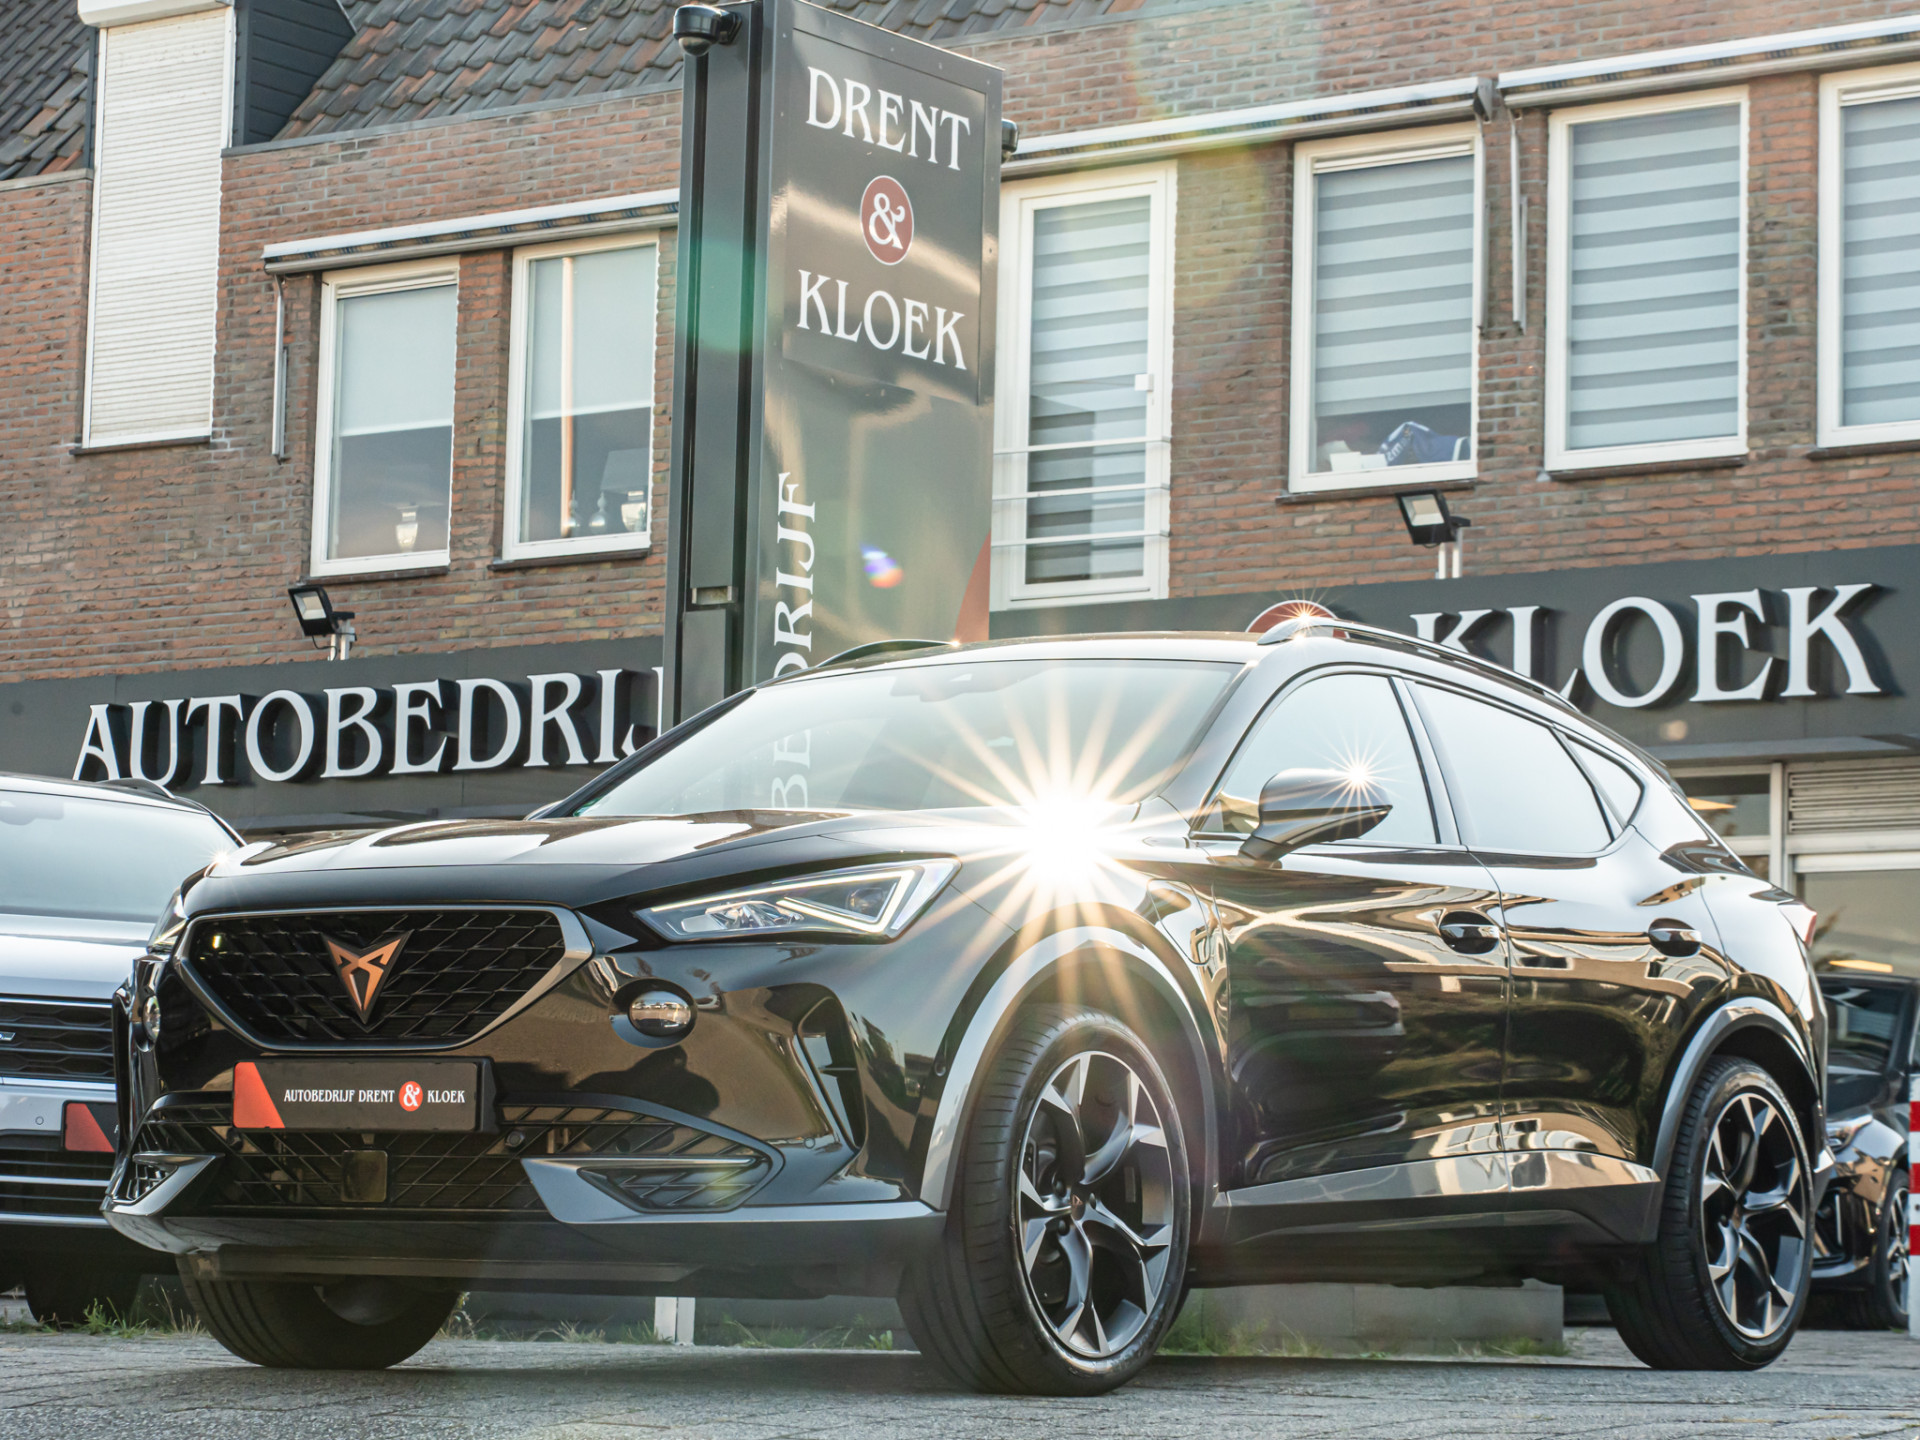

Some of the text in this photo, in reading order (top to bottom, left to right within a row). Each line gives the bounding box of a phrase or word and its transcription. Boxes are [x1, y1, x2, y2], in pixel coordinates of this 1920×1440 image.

[805, 66, 970, 171] DRENT
[868, 192, 906, 250] &
[796, 269, 967, 371] KLOEK
[283, 1084, 466, 1107] AUTOBEDRIJF DRENT & KLOEK
